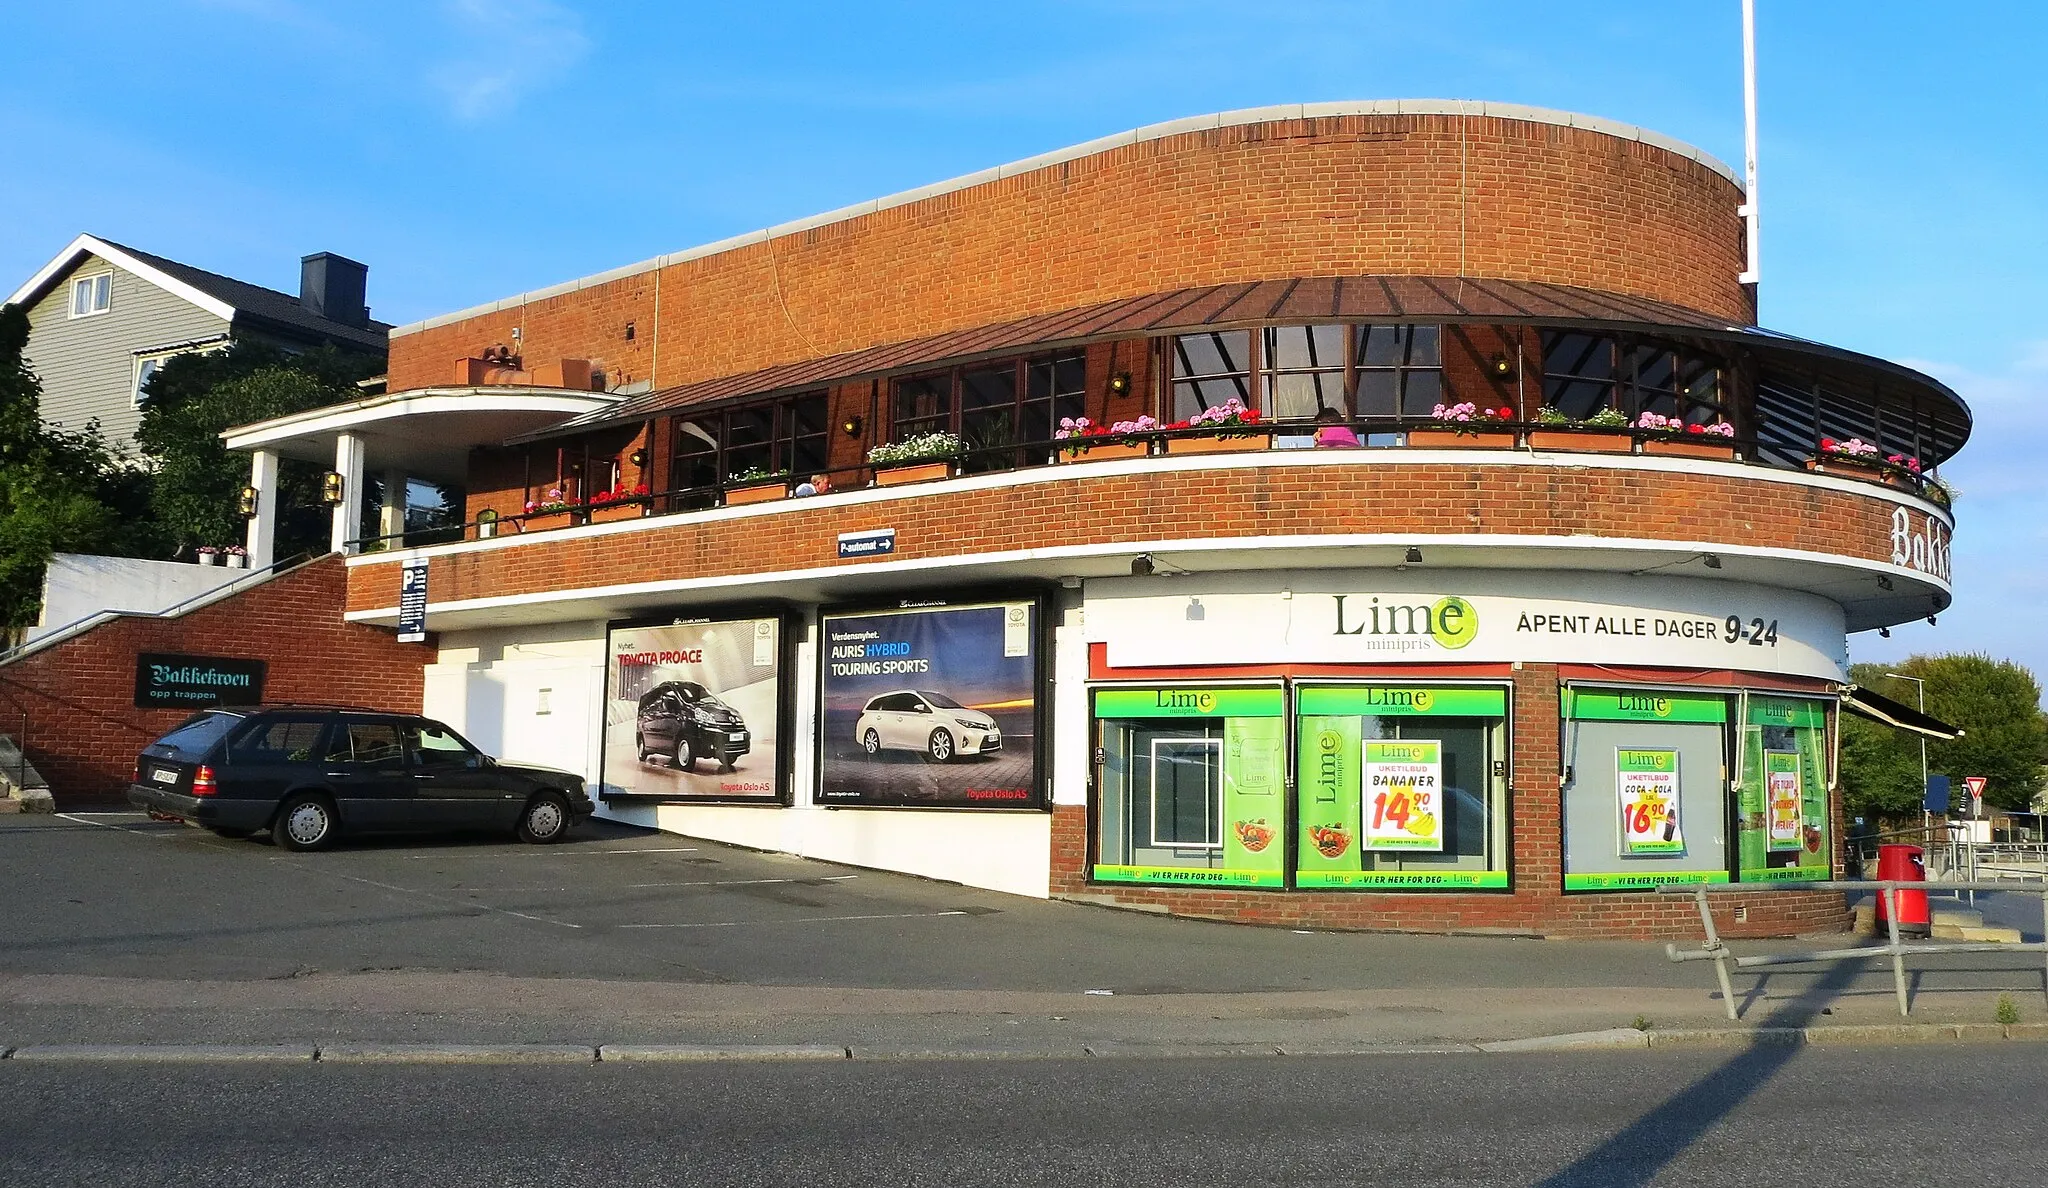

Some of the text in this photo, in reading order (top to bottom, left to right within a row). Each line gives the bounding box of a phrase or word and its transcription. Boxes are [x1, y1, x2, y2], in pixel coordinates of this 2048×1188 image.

[841, 540, 876, 553] P-automat
[402, 569, 414, 591] P
[1332, 595, 1463, 636] Lime
[831, 630, 880, 641] Verdensnyhet.
[1516, 611, 1778, 648] ÅPENT ALLE DAGER 9-24
[831, 642, 910, 659] AURIS HYBRID
[1367, 638, 1431, 653] minipris
[617, 649, 702, 666] TOYOTA PROACE
[149, 664, 250, 686] Bakkekroen
[831, 659, 929, 676] TOURING SPORTS
[150, 690, 216, 700] opp trappen
[1156, 689, 1211, 707] Lime
[1366, 687, 1426, 705] Lime
[1618, 691, 1666, 711] Lime
[1381, 744, 1420, 757] Lime
[1628, 752, 1663, 765] Lime
[1316, 737, 1336, 804] Lime
[720, 782, 770, 792] Toyota Oslo AS
[1373, 775, 1434, 787] BANANER
[966, 787, 1028, 801] Toyota Oslo AS
[1372, 792, 1430, 829] 14 90
[1625, 804, 1665, 833] 16 90
[1118, 868, 1140, 877] Lime
[1174, 872, 1189, 880] HER
[1233, 872, 1257, 881] Lime
[1325, 874, 1350, 883] Lime
[1374, 876, 1386, 884] ER
[1387, 876, 1405, 884] HER
[1407, 876, 1423, 884] FOR
[1454, 874, 1478, 882] Lime
[1688, 874, 1708, 882] Lime
